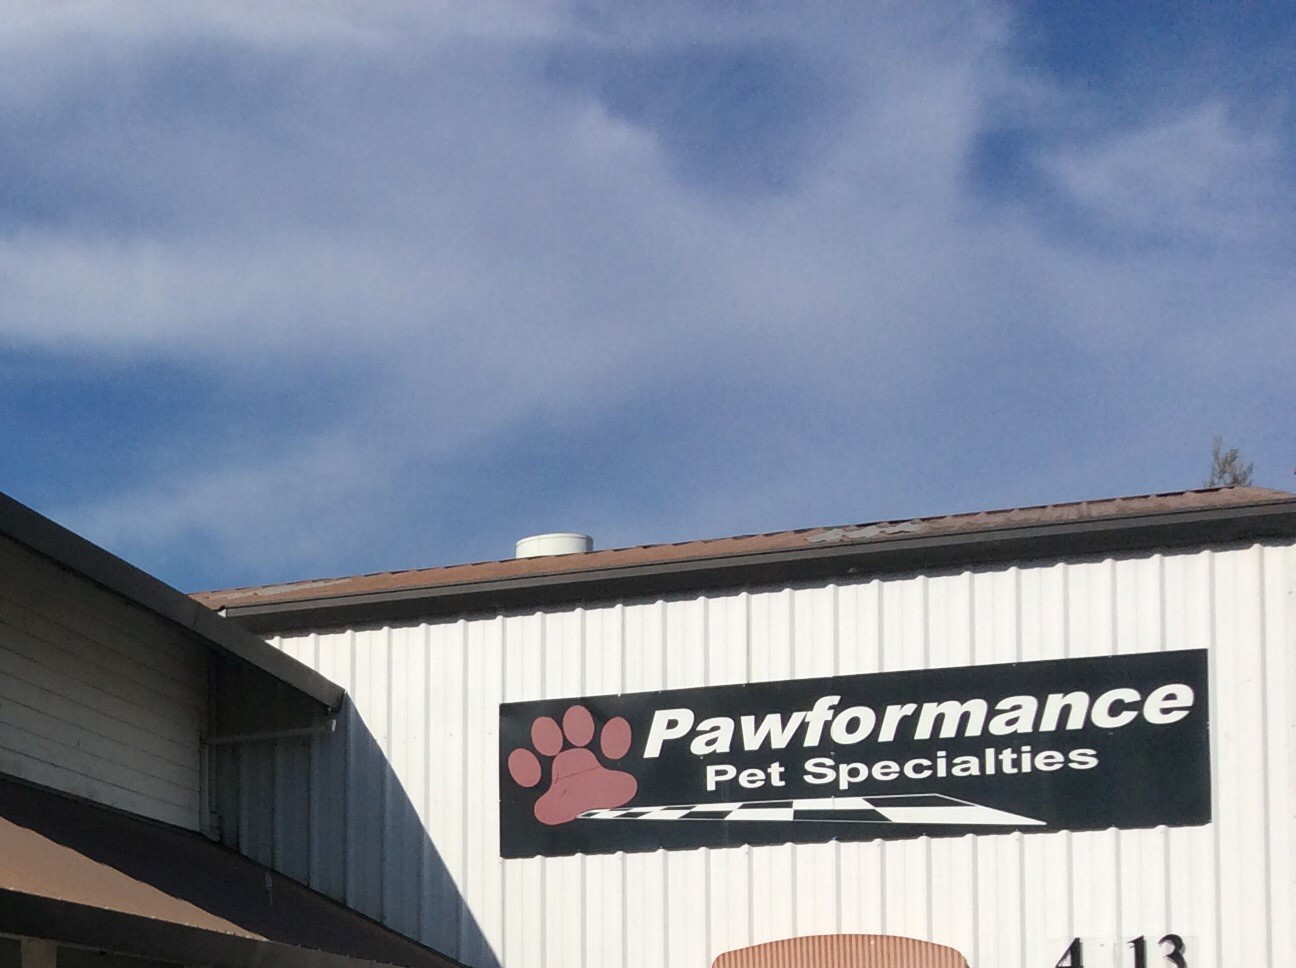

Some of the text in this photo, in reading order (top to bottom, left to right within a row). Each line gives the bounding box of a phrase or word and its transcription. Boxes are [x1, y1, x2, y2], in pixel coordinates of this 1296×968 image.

[643, 682, 1195, 758] Pawformance
[705, 745, 1099, 791] Pet Specialties
